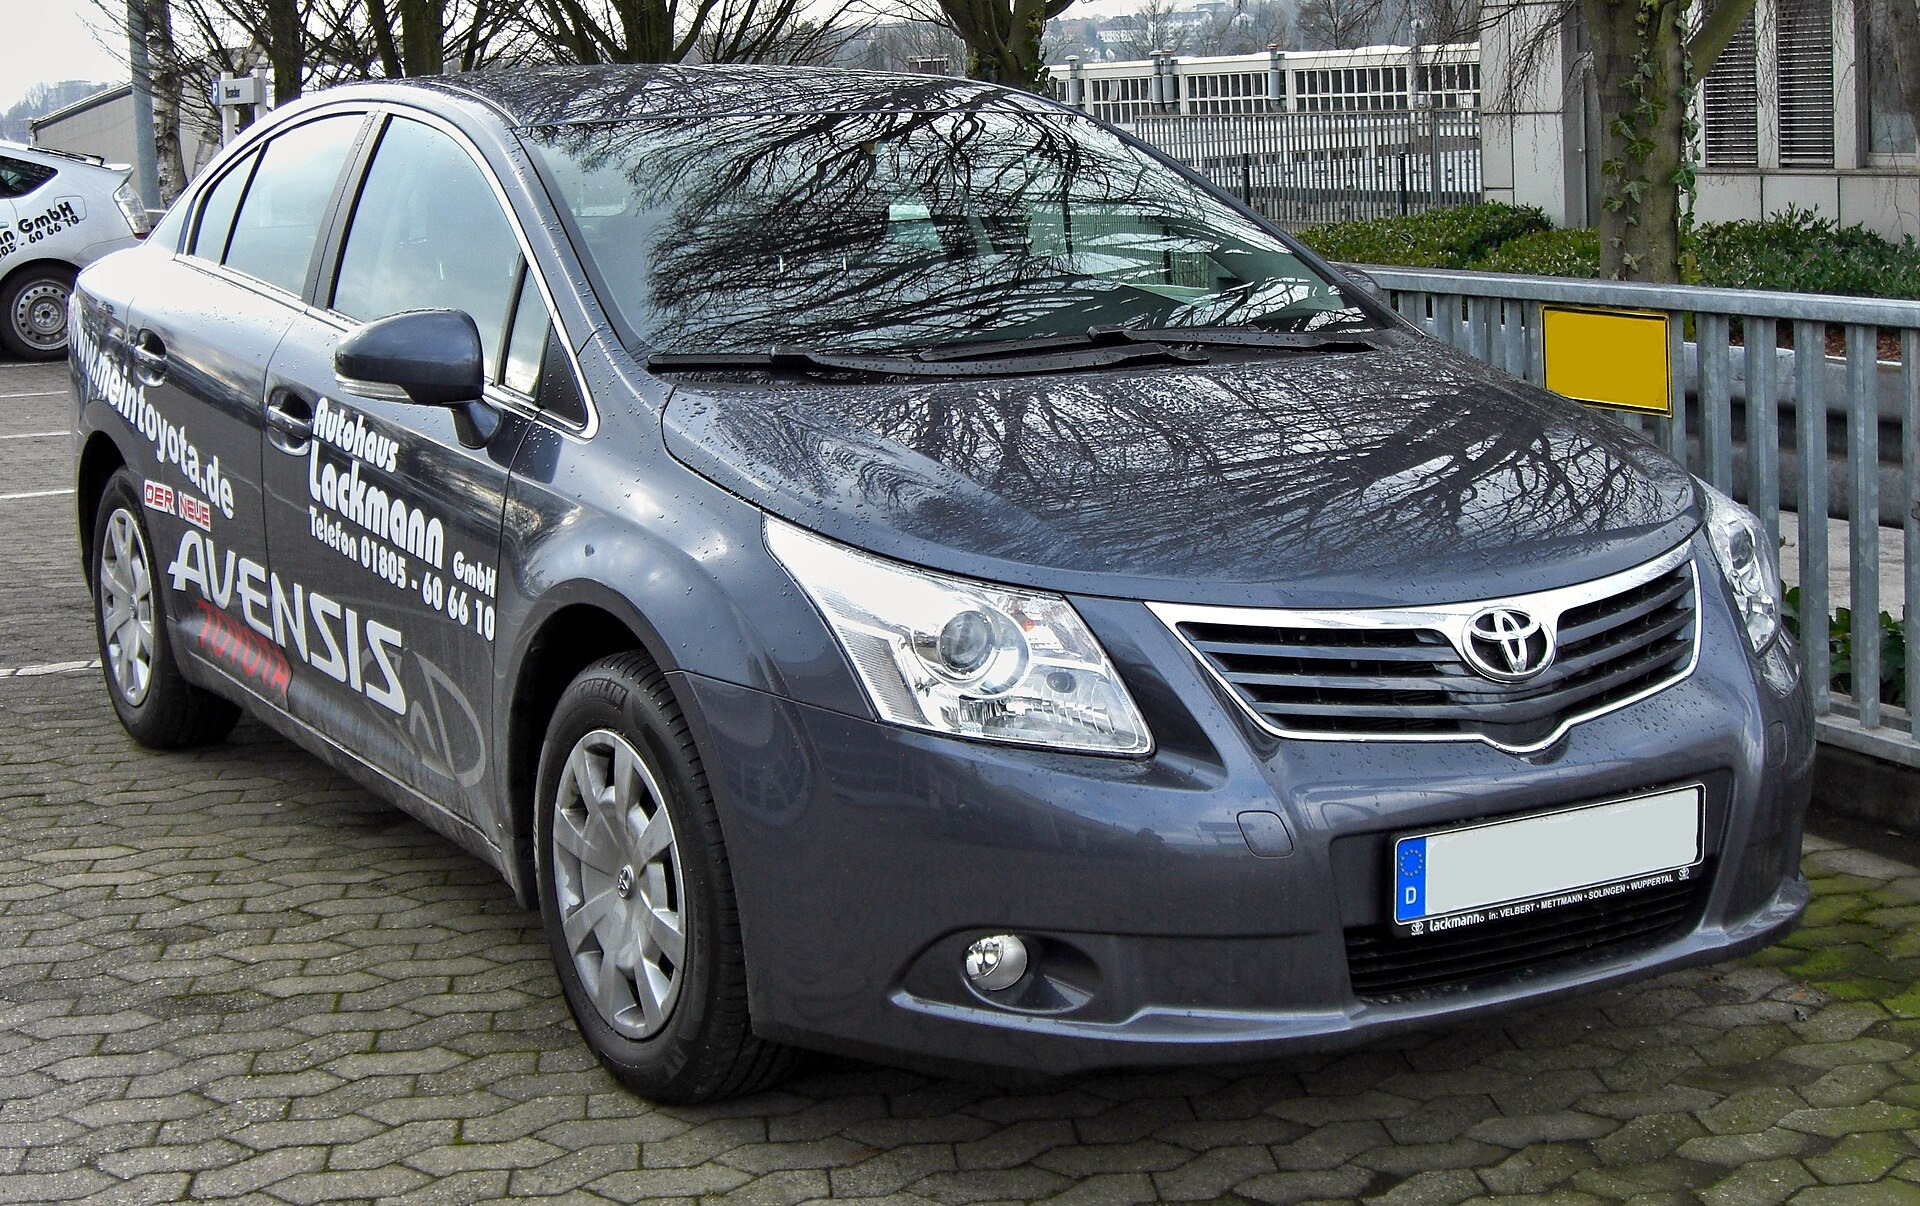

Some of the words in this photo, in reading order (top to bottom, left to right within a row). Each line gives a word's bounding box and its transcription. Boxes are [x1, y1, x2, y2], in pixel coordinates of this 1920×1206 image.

[0, 242, 17, 259] 05
[28, 230, 44, 244] 60
[46, 222, 62, 236] 66
[63, 215, 80, 228] 10
[18, 201, 75, 234] GmbH
[70, 318, 234, 520] www.meintoyota.de
[313, 397, 399, 473] Autohaus
[144, 479, 175, 516] DER
[178, 490, 211, 532] NEUE
[309, 440, 444, 570] Lackmann
[453, 551, 497, 599] GmbH
[309, 505, 358, 562] Telefon
[360, 535, 406, 590] 01805
[422, 572, 443, 611] 60
[447, 586, 469, 626] 66
[475, 599, 495, 642] 10
[167, 529, 407, 715] AVENSIS
[196, 599, 293, 698] TOYOTA
[1405, 886, 1417, 905] D
[1488, 911, 1499, 920] in:
[1500, 903, 1535, 918] VELBERT
[1541, 894, 1583, 910] METTMANN
[1588, 884, 1626, 900] SOLINGEN
[1631, 874, 1674, 891] WUPPERTAL
